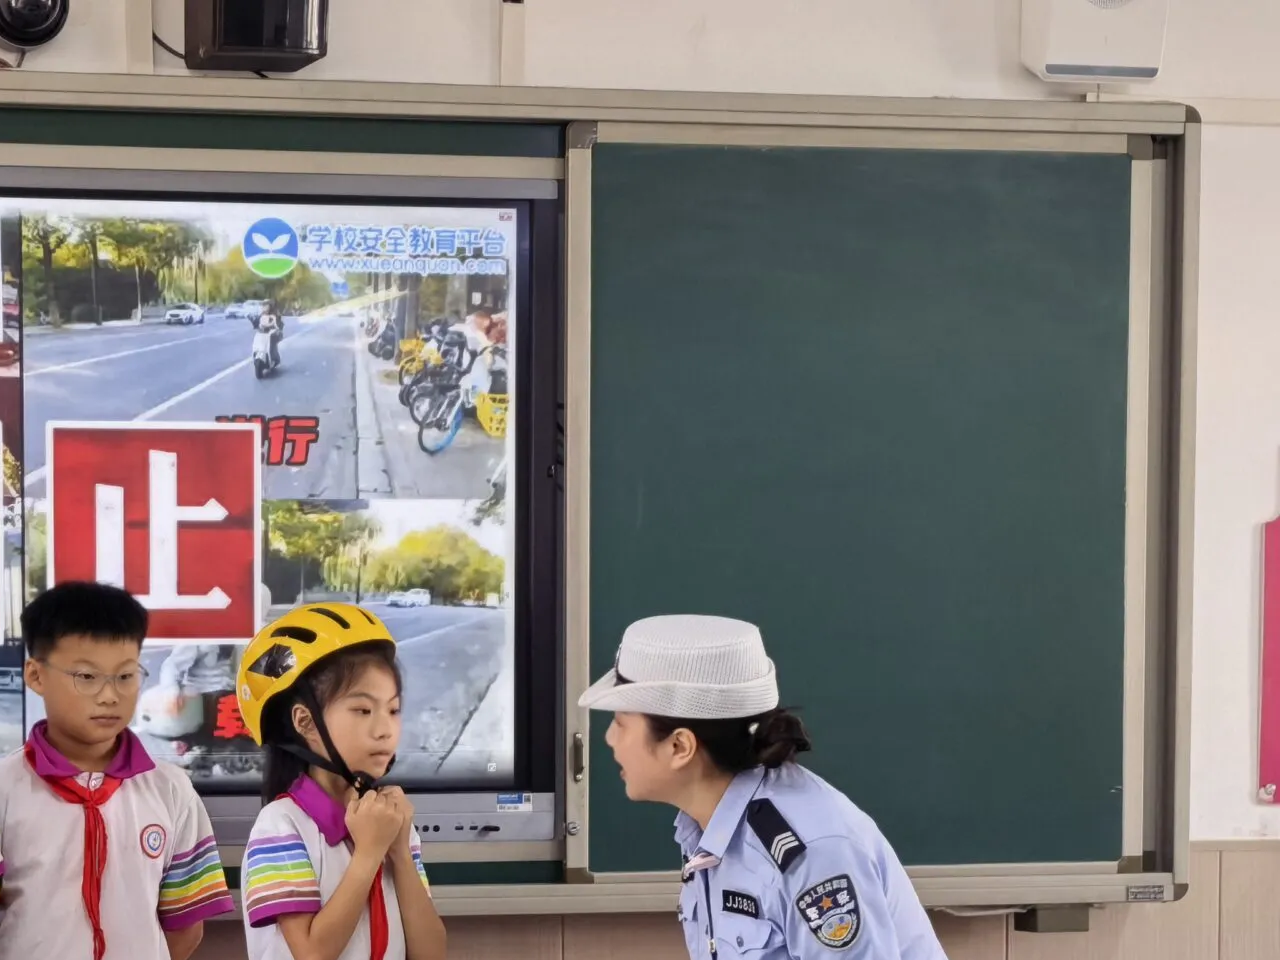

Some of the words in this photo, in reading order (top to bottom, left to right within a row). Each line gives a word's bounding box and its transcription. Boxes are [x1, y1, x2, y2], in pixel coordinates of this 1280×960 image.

[308, 227, 506, 255] 学校安全教育平台
